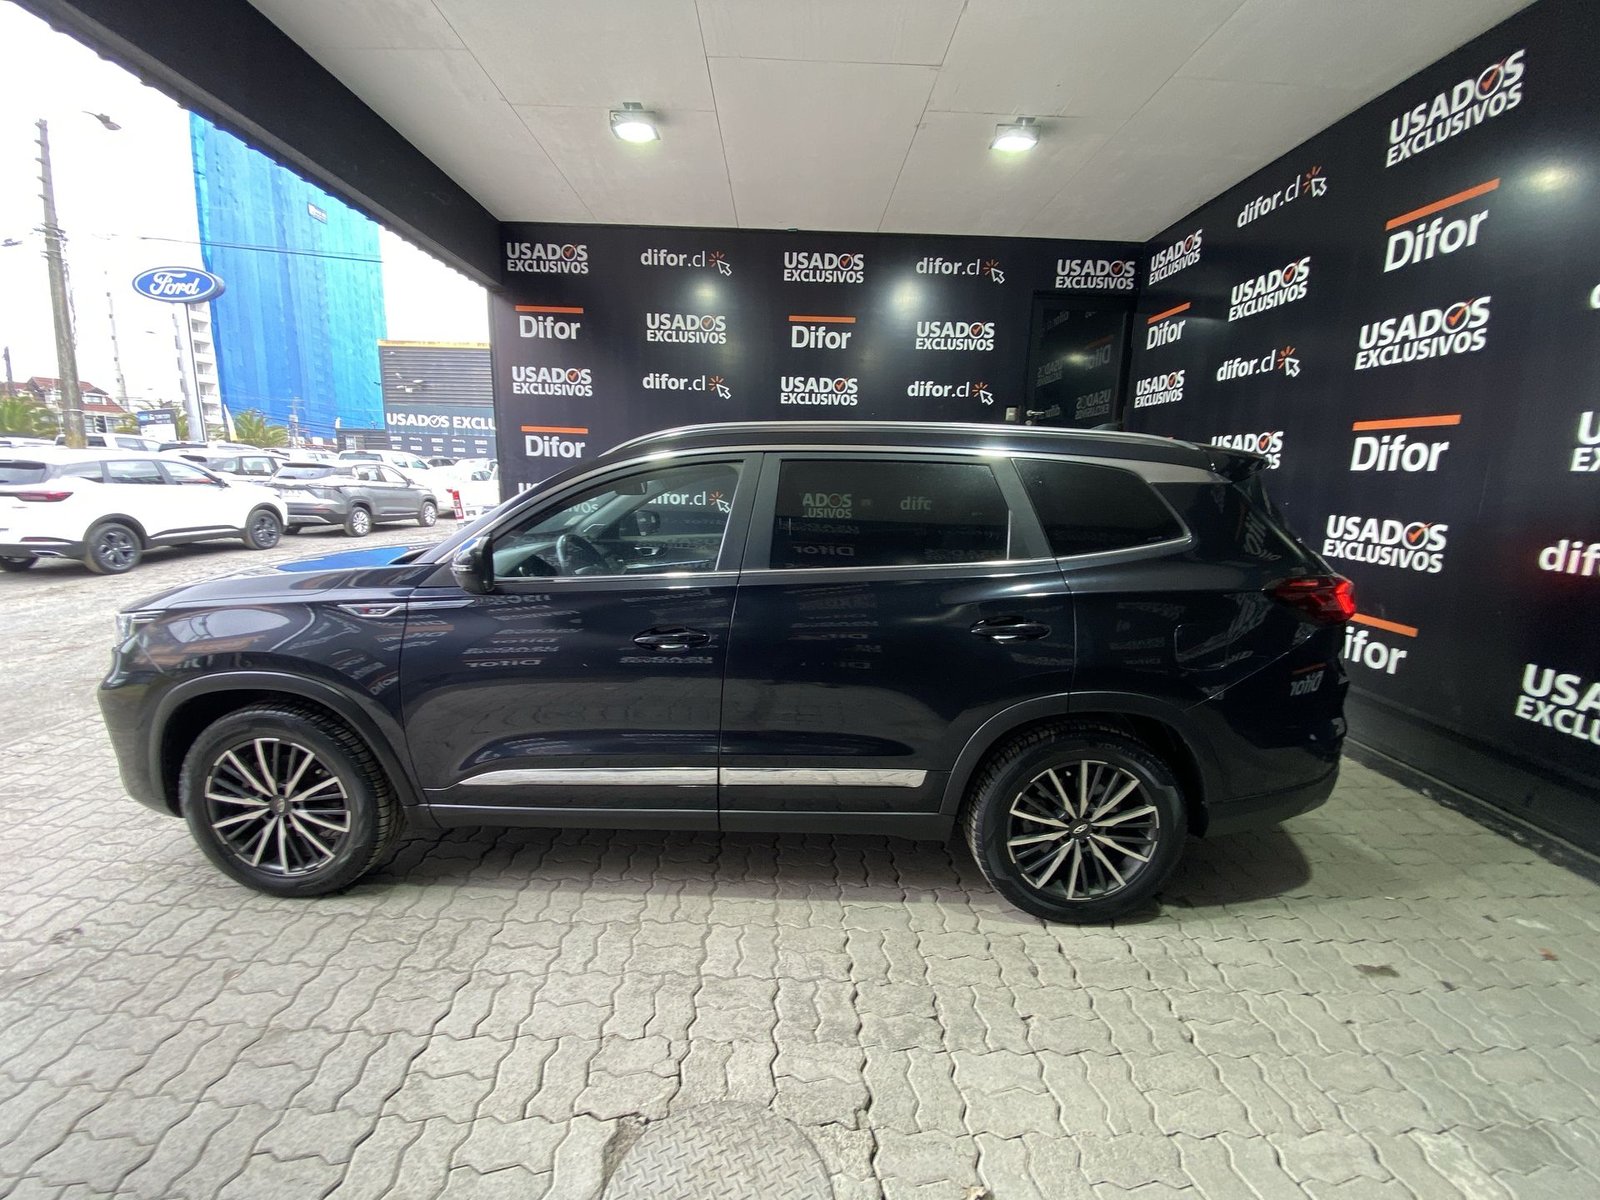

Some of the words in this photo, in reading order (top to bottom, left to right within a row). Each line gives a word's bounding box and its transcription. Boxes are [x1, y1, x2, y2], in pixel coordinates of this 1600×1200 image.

[1389, 49, 1525, 146] USADOS
[1385, 82, 1522, 168] EXCLUSIVOS
[1237, 174, 1301, 228] difor.cl
[506, 242, 588, 262] USADOS
[1150, 229, 1203, 271] USADOS
[1383, 210, 1489, 273] Difor
[507, 260, 589, 274] EXCLUSIVOS
[640, 249, 706, 267] difor.cl
[784, 252, 864, 271] USADOS
[915, 257, 980, 276] difor.cl
[1056, 259, 1135, 277] USADOS
[1148, 248, 1201, 286] EXCLUSIVOS
[150, 272, 200, 295] Ford
[784, 269, 864, 284] EXCLUSIVOS
[1055, 275, 1134, 290] EXCLUSIVOS
[1231, 256, 1311, 306] USADOS
[1228, 281, 1308, 322] EXCLUSIVOS
[519, 315, 581, 340] Difor
[646, 313, 726, 332] USADOS
[916, 321, 995, 339] USADOS
[1358, 296, 1491, 351] USADOS
[646, 330, 727, 345] EXCLUSIVOS
[791, 325, 851, 349] Difor
[915, 336, 994, 351] EXCLUSIVOS
[1146, 319, 1185, 350] Difor
[1354, 328, 1487, 371] EXCLUSIVOS
[512, 366, 592, 385] USADOS
[1216, 349, 1276, 381] difor.cl
[512, 382, 593, 397] EXCLUSIVOS
[642, 373, 706, 391] difor.cl
[780, 376, 858, 395] USADOS
[907, 380, 969, 398] difor.cl
[1136, 370, 1185, 396] USADOS
[780, 393, 858, 406] EXCLUSIVOS
[1134, 388, 1183, 408] EXCLUSIVOS
[387, 413, 449, 428] USADOS
[525, 435, 586, 458] Difor
[1350, 435, 1450, 472] Difor
[802, 507, 852, 518] USIVOS
[1326, 514, 1449, 552] USADOS
[1322, 539, 1444, 573] EXCLUSIVOS
[1538, 539, 1600, 576] dif
